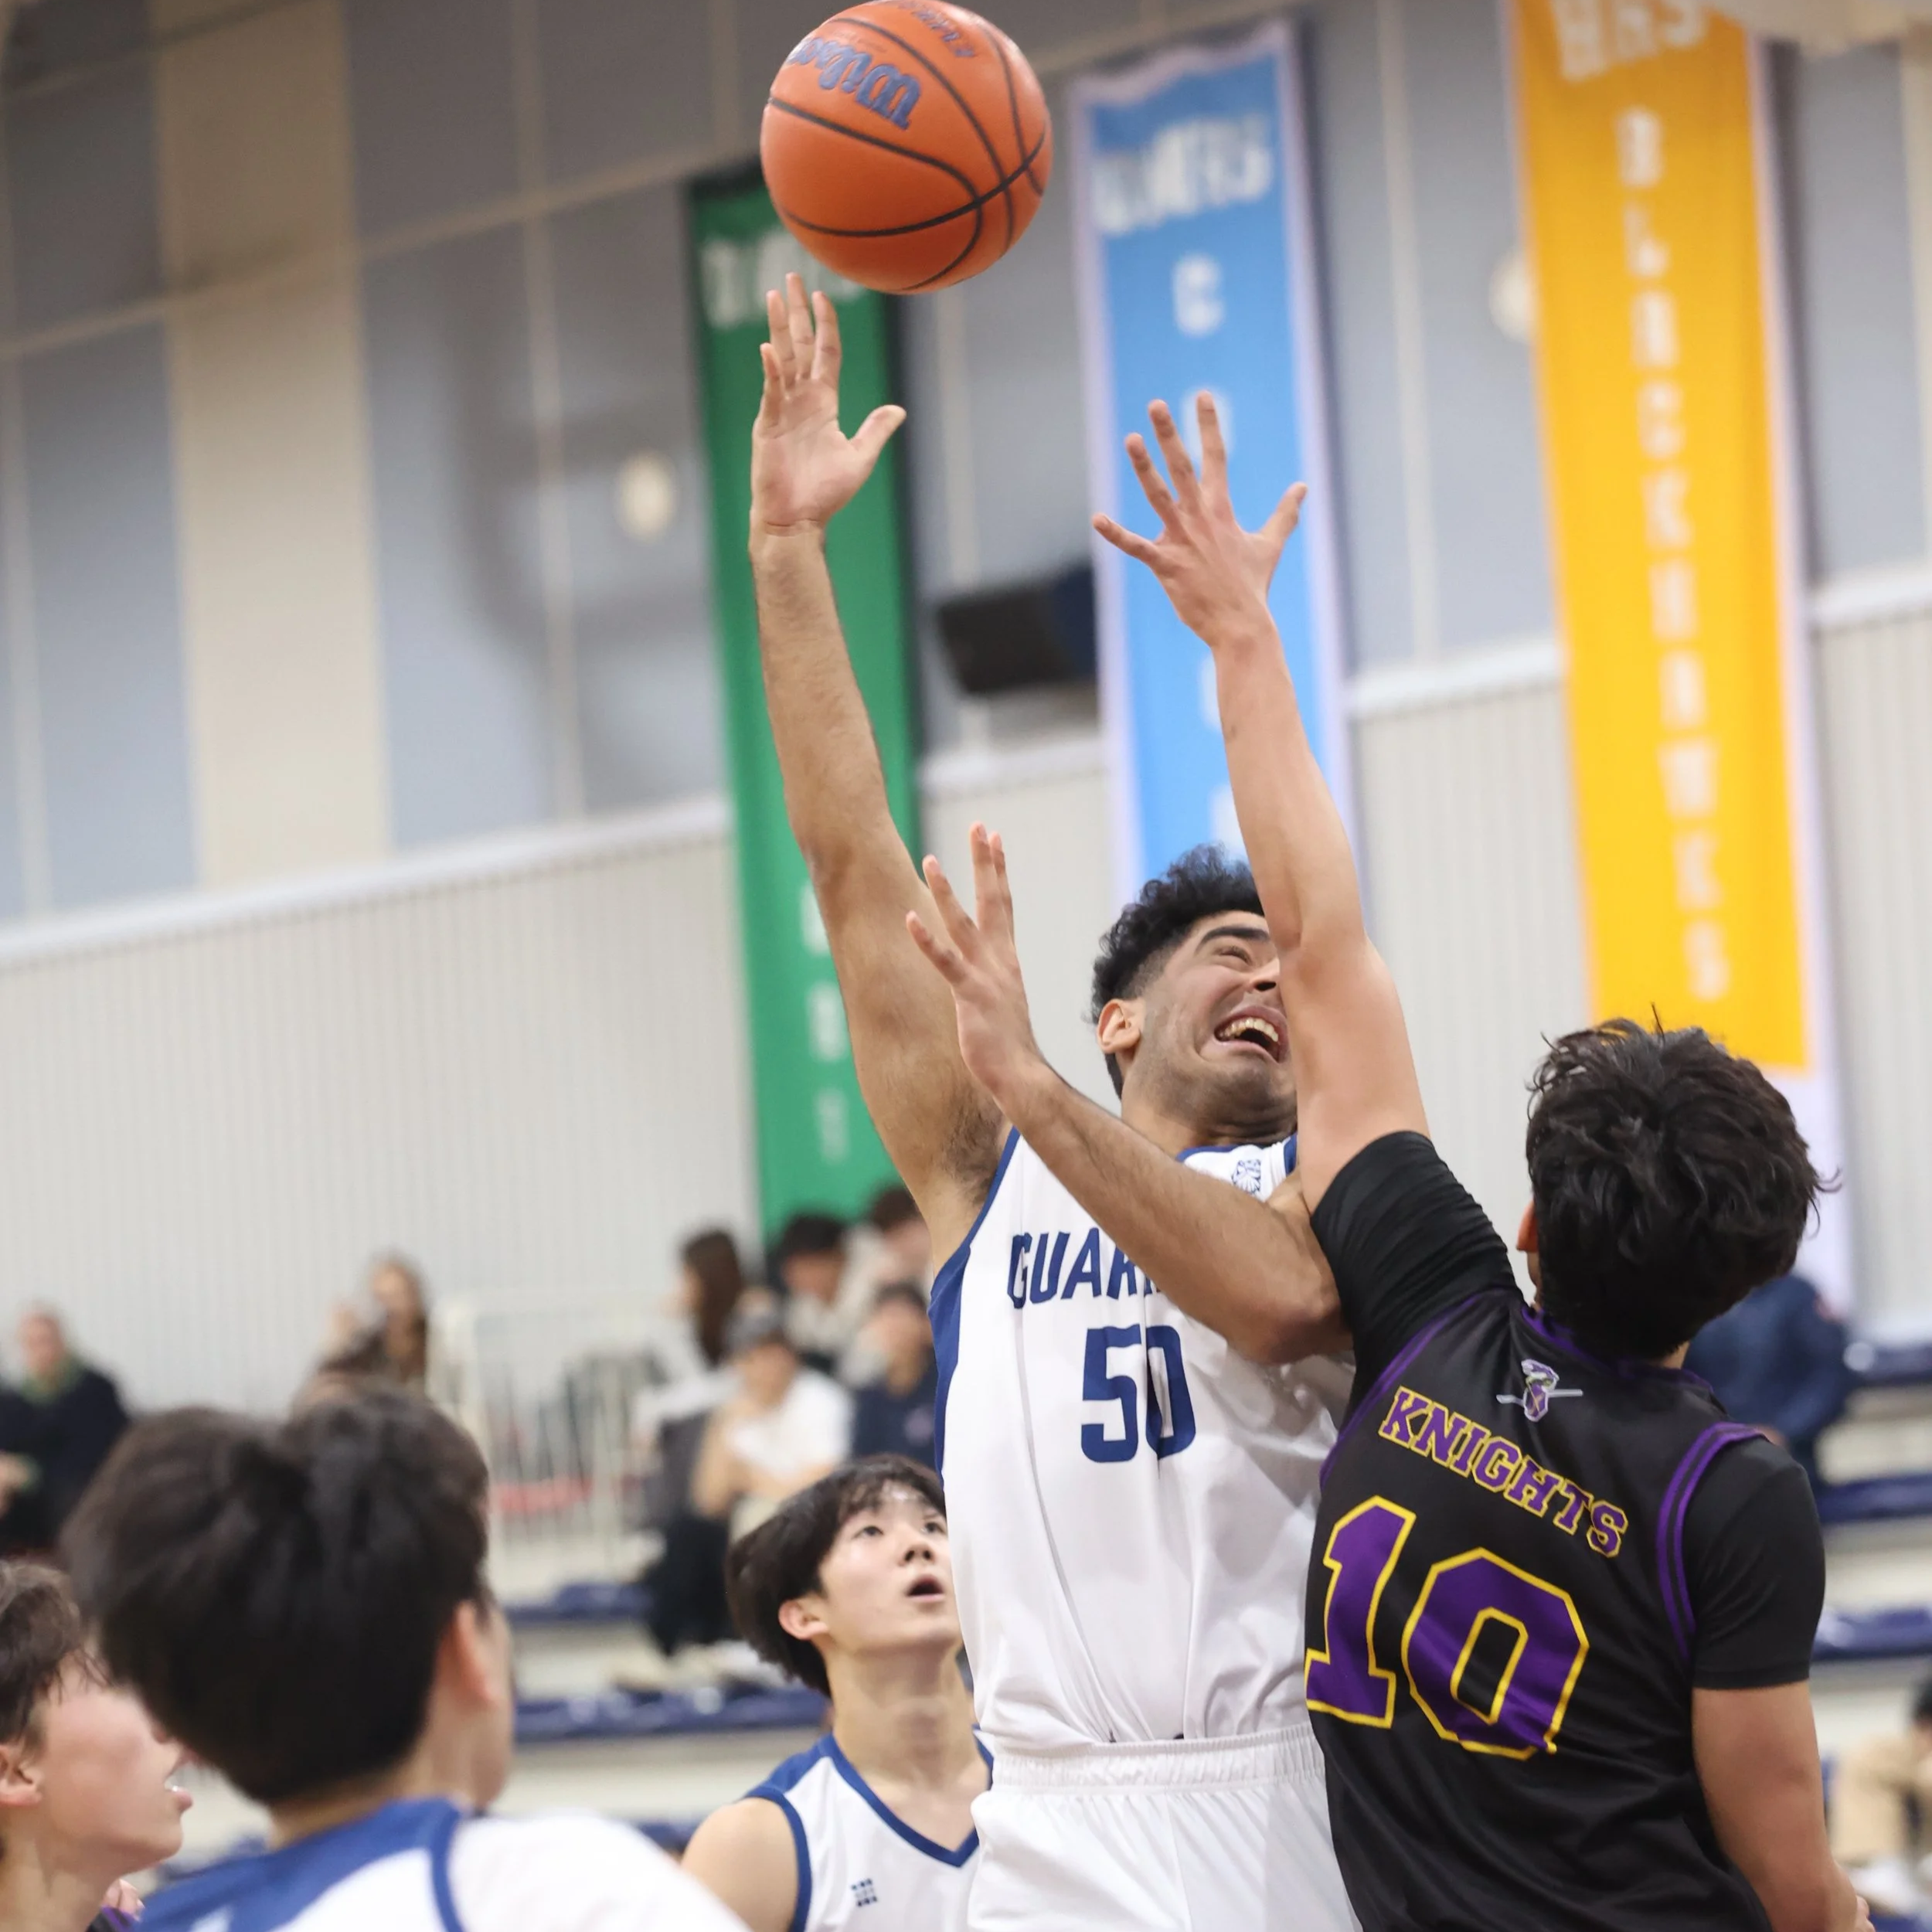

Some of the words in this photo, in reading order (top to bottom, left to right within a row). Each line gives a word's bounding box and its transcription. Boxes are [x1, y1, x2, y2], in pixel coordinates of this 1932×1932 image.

[1007, 1226, 1161, 1309] GUAR
[1081, 1323, 1196, 1463] 50
[1378, 1386, 1628, 1558] KNIGHTS
[1304, 1495, 1590, 1760] 10
